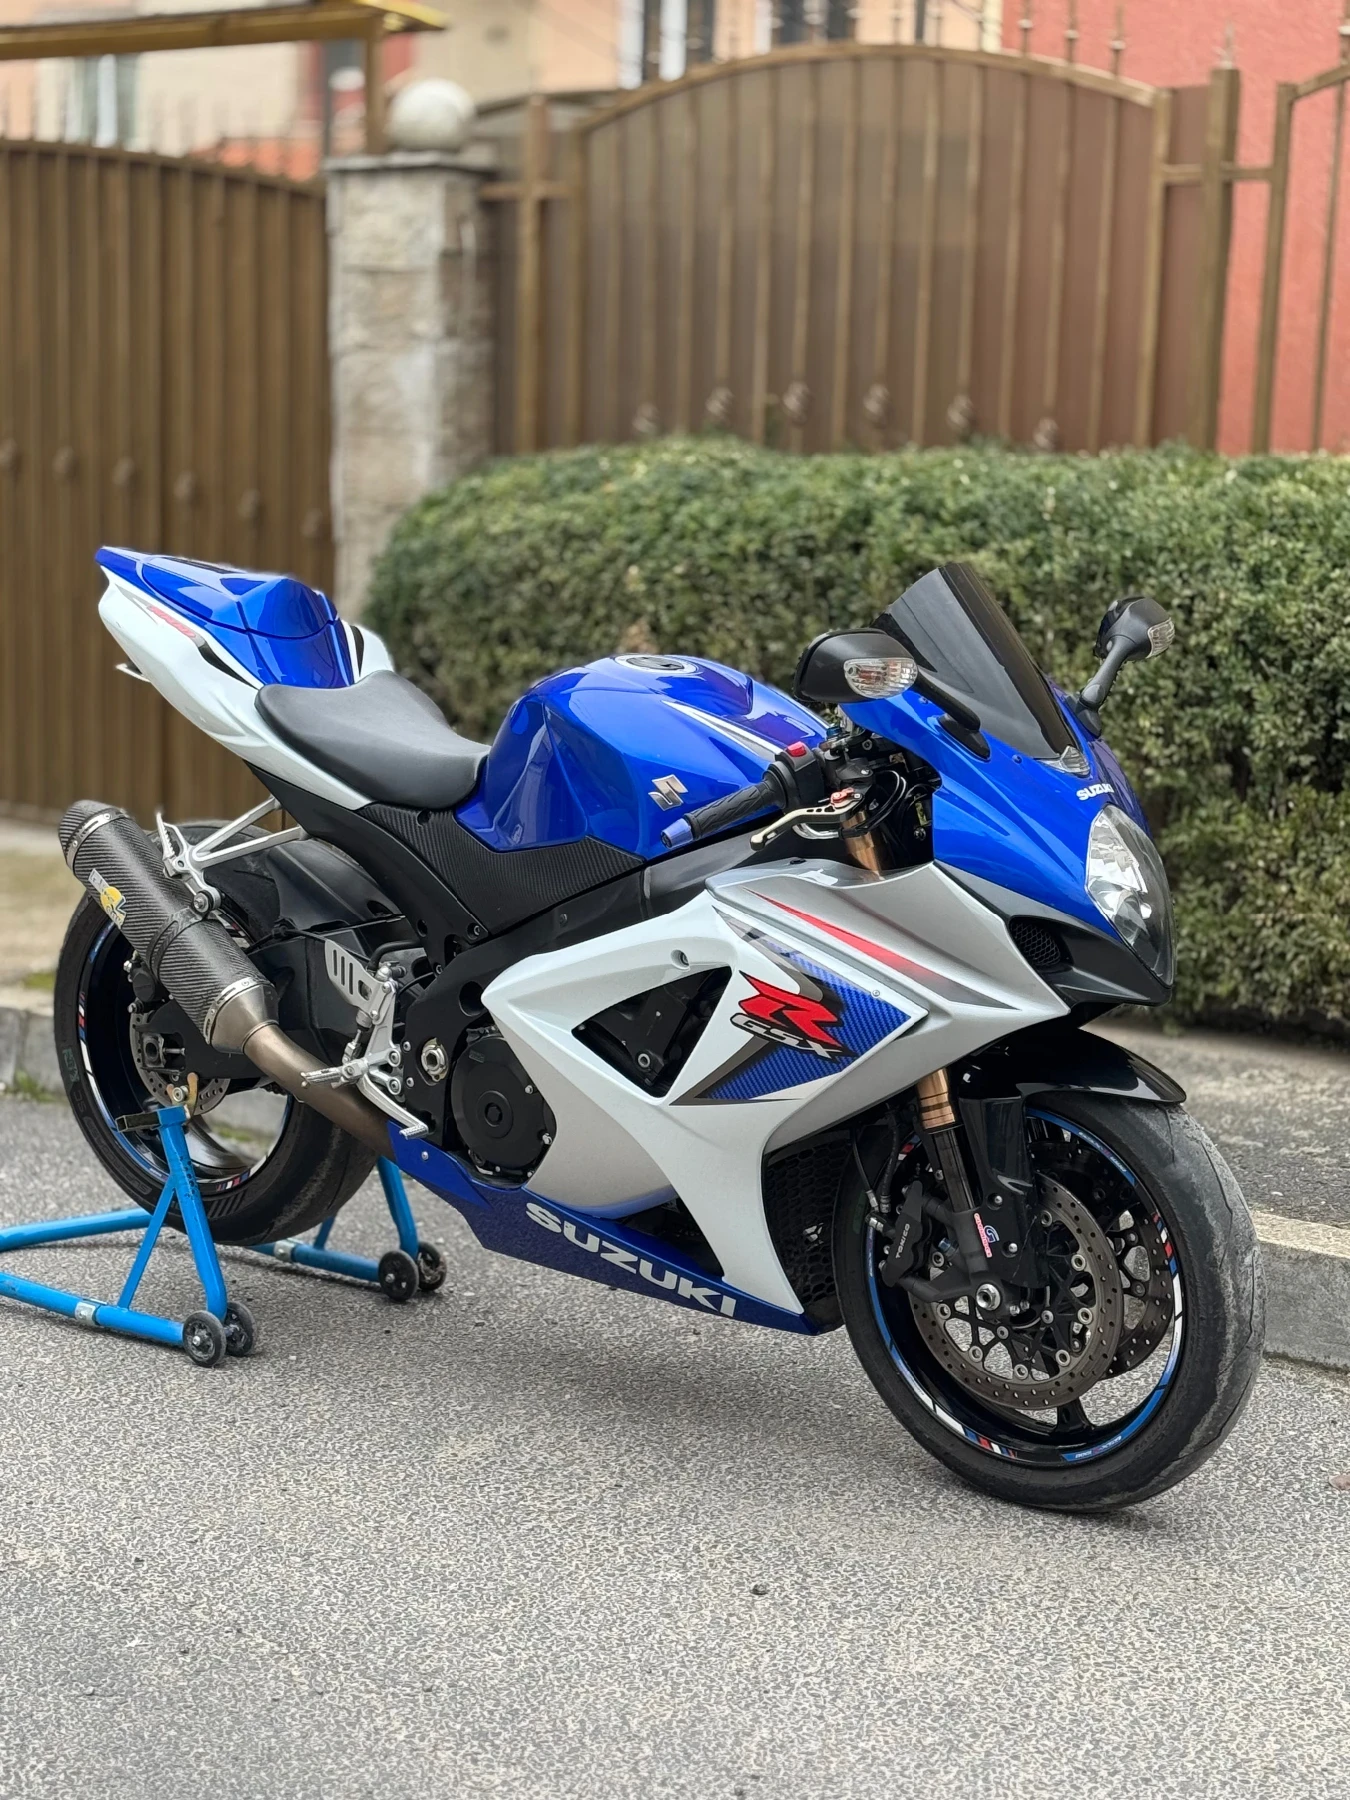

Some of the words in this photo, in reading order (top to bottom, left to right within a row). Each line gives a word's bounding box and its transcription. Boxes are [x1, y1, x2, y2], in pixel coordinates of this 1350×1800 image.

[730, 1013, 843, 1060] GSX
[525, 1202, 737, 1318] SUZUKI
[895, 1223, 911, 1259] TOKICO
